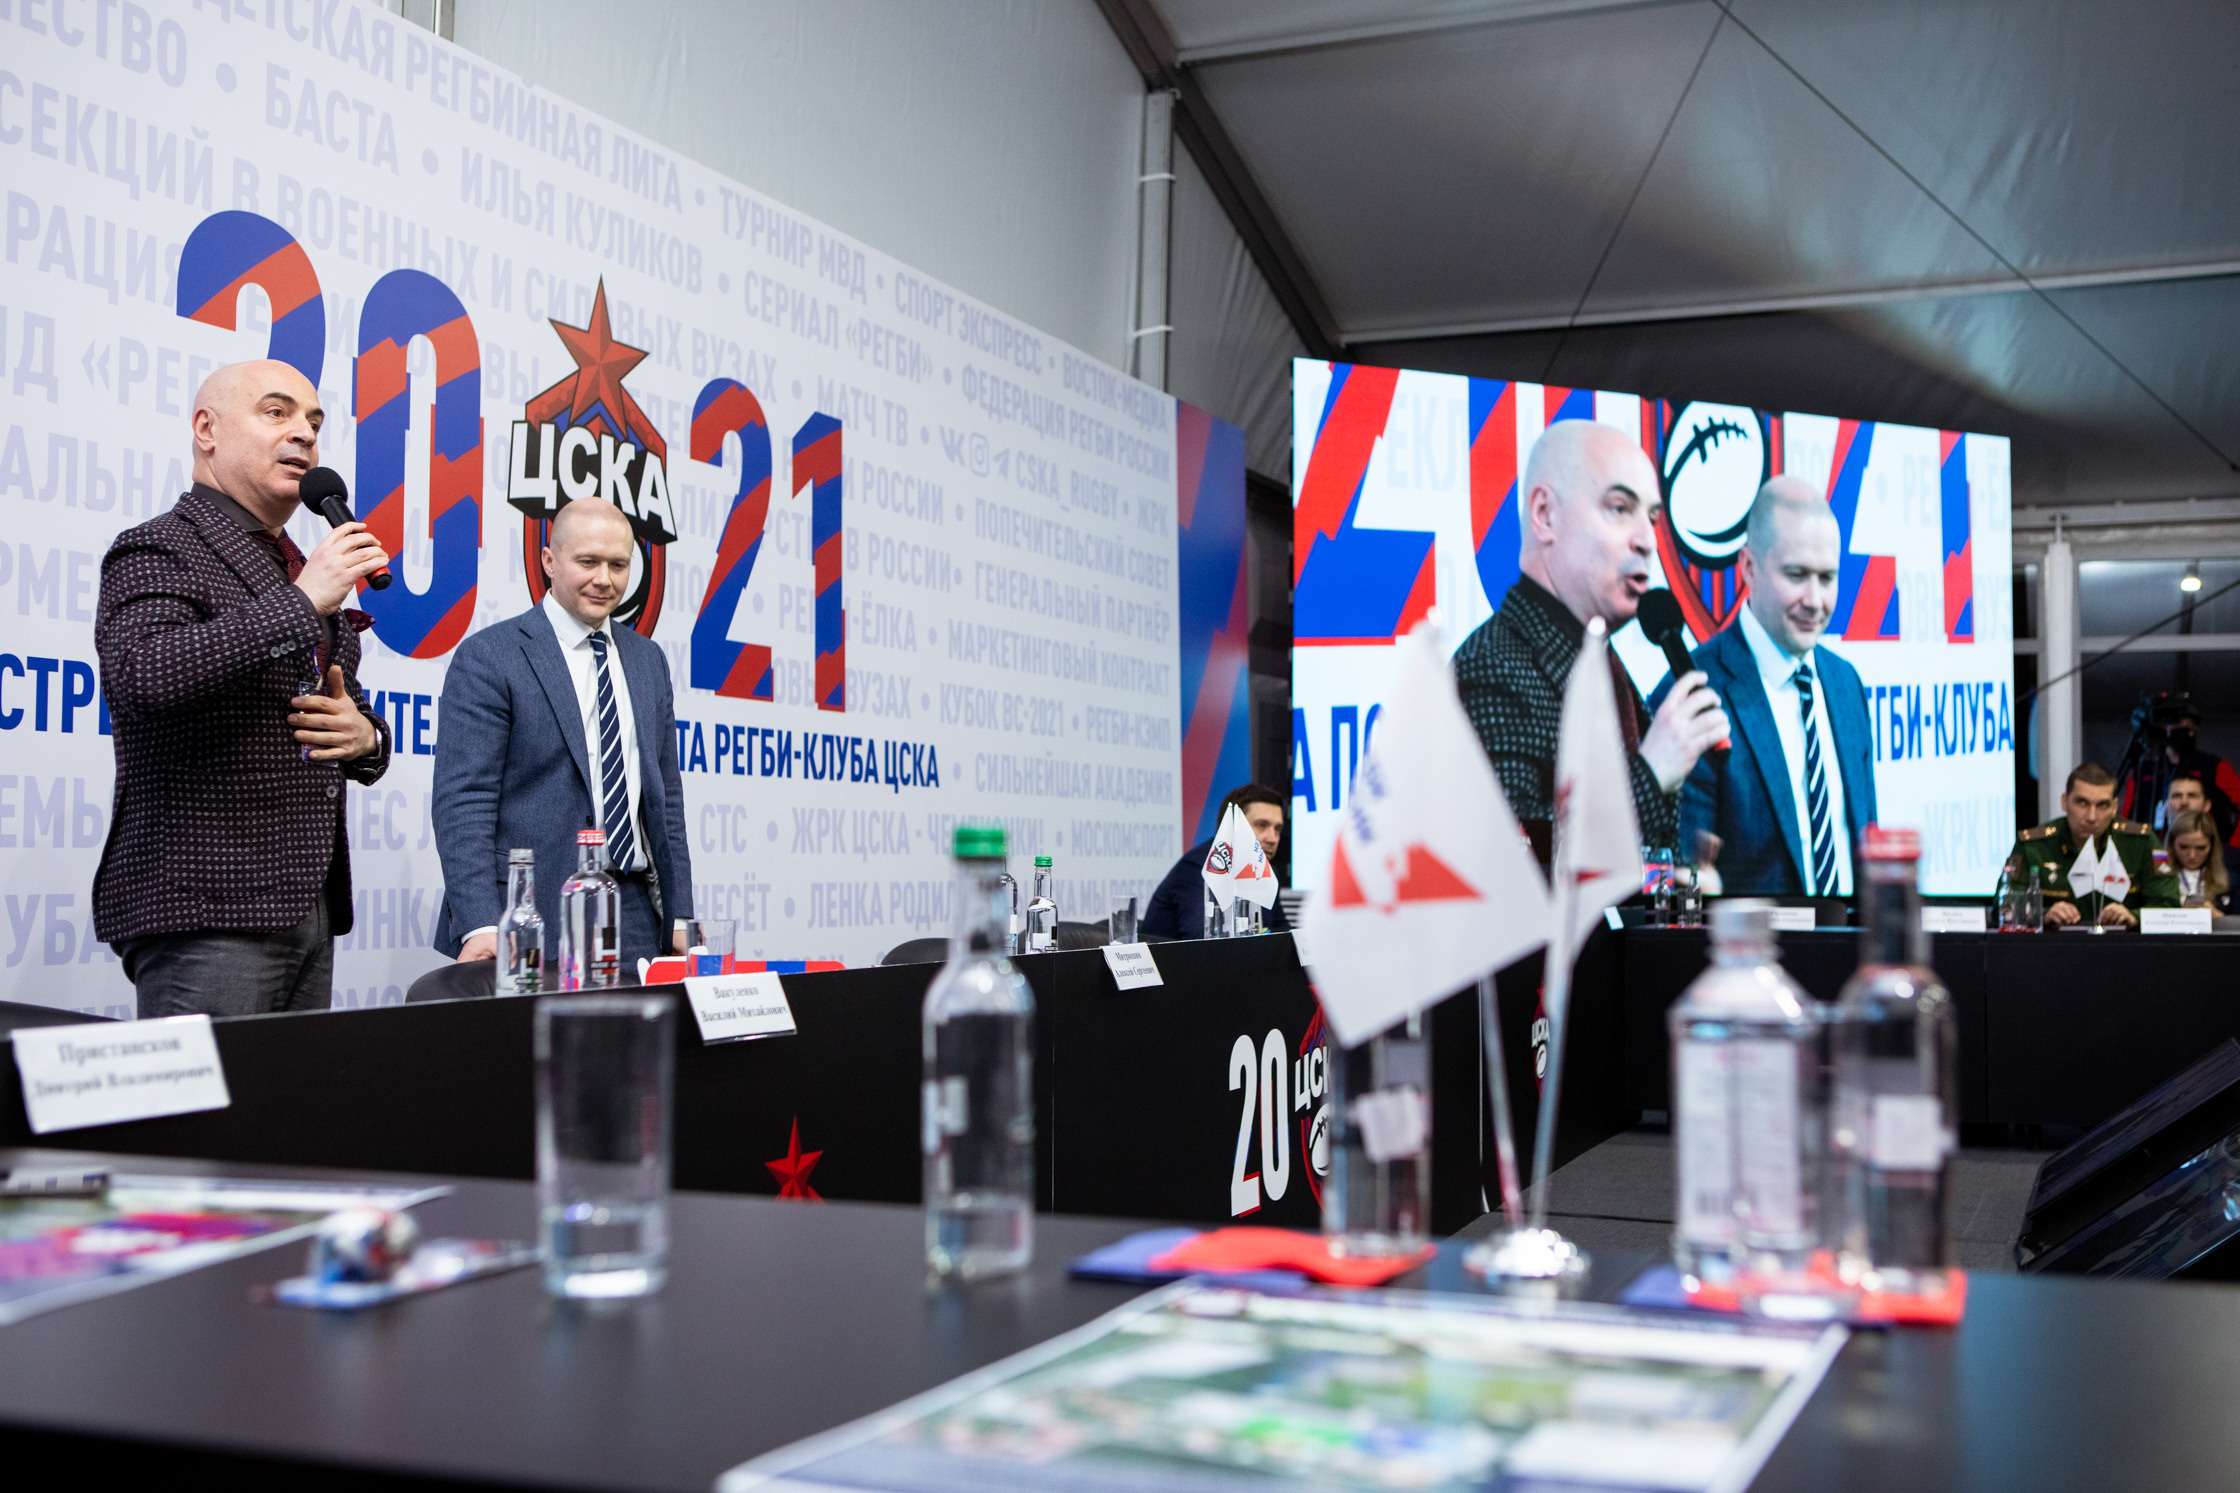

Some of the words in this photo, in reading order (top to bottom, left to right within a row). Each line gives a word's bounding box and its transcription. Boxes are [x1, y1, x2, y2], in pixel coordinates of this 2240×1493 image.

[405, 32, 602, 177] РЕГБИЙНАЯ
[609, 134, 682, 214] ЛИГА
[719, 185, 813, 269] ТУРНИР
[819, 233, 867, 305] МВД
[895, 271, 954, 336] СПОРТ
[959, 302, 1042, 376] ЭКСПРЕСС
[265, 62, 399, 175] БАСТА
[461, 146, 555, 238] ИЛЬЯ
[565, 191, 702, 295] КУЛИКОВ
[744, 269, 839, 350] СЕРИАЛ
[962, 363, 1065, 441] ФЕДЕРАЦИЯ
[1069, 398, 1114, 461] РЕГБИ
[491, 252, 512, 314] И
[692, 327, 776, 403] ВУЗАХ
[817, 374, 876, 437] МАТЧ
[884, 398, 909, 447] ТВ
[508, 420, 677, 541] ЦСКА
[862, 461, 943, 527] РОССИИ
[975, 497, 1124, 579] ПОПЕЧИТЕЛЬСКИЙ
[1128, 546, 1170, 592] СОВЕТ
[868, 531, 951, 594] РОССИИ
[974, 560, 1100, 630] ГЕНЕРАЛЬНЫЙ
[1106, 595, 1170, 644] ПАРТНЁР
[947, 618, 1097, 686] МАРКЕТИНГОВЫЙ
[1101, 652, 1170, 698] КОНТРАКТ
[846, 667, 911, 719] ВУЗАХ
[940, 682, 998, 731] КУБОК
[1003, 697, 1064, 738] ВС-2021
[1864, 681, 2014, 762] ГБИ-КЛУБА
[715, 723, 879, 784] РЕГБИ-КЛУБА
[884, 737, 940, 794] ЦСКА
[974, 750, 1091, 800] СИЛЬНЕЙШАЯ
[1095, 762, 1173, 809] АКАДЕМИЯ
[791, 806, 845, 856] ЖРК
[852, 809, 909, 863] ЦСКА
[1070, 819, 1174, 858] МОСКОМСПОРТ
[808, 881, 880, 928] ЛЕНКА
